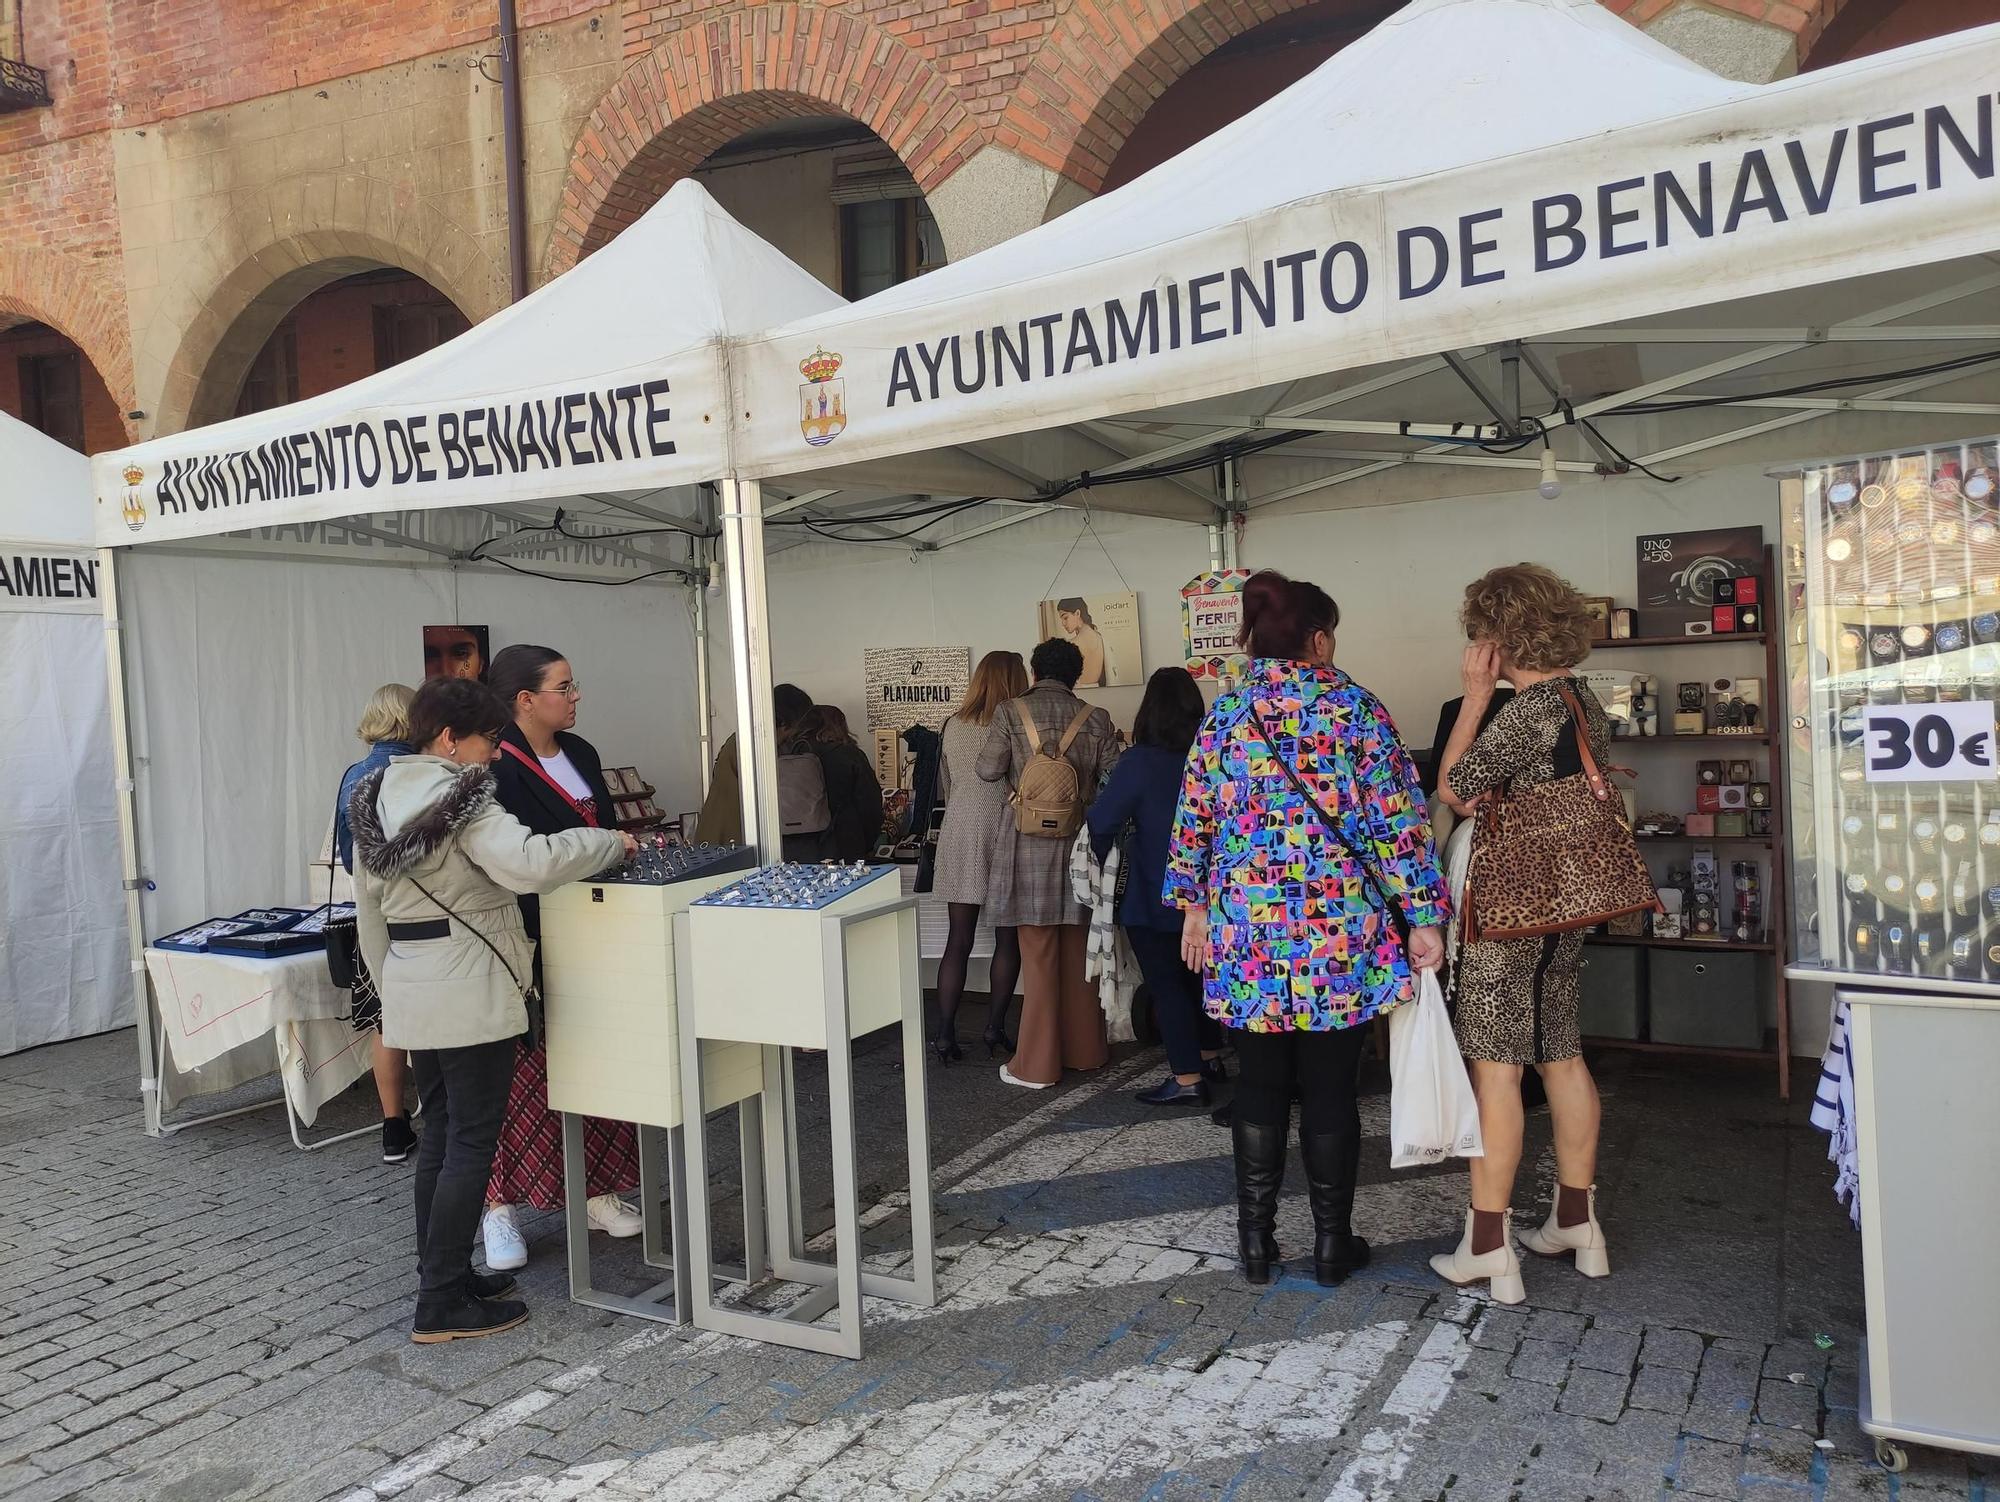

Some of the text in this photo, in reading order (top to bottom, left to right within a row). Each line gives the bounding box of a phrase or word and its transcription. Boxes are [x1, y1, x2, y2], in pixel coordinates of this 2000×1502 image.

[887, 91, 2000, 408] AYUNTAMIENTO DE BENAVEN
[156, 379, 677, 516] AYUNTAMIENTO DE BENAVENTE
[1643, 538, 1672, 551] UNO
[0, 556, 100, 598] AMIEN
[1193, 594, 1240, 612] Benavente
[1196, 612, 1237, 626] FERIA
[883, 685, 950, 702] PLATADEPALO
[1717, 726, 1753, 735] FOSSIL
[1869, 714, 1990, 771] 30€
